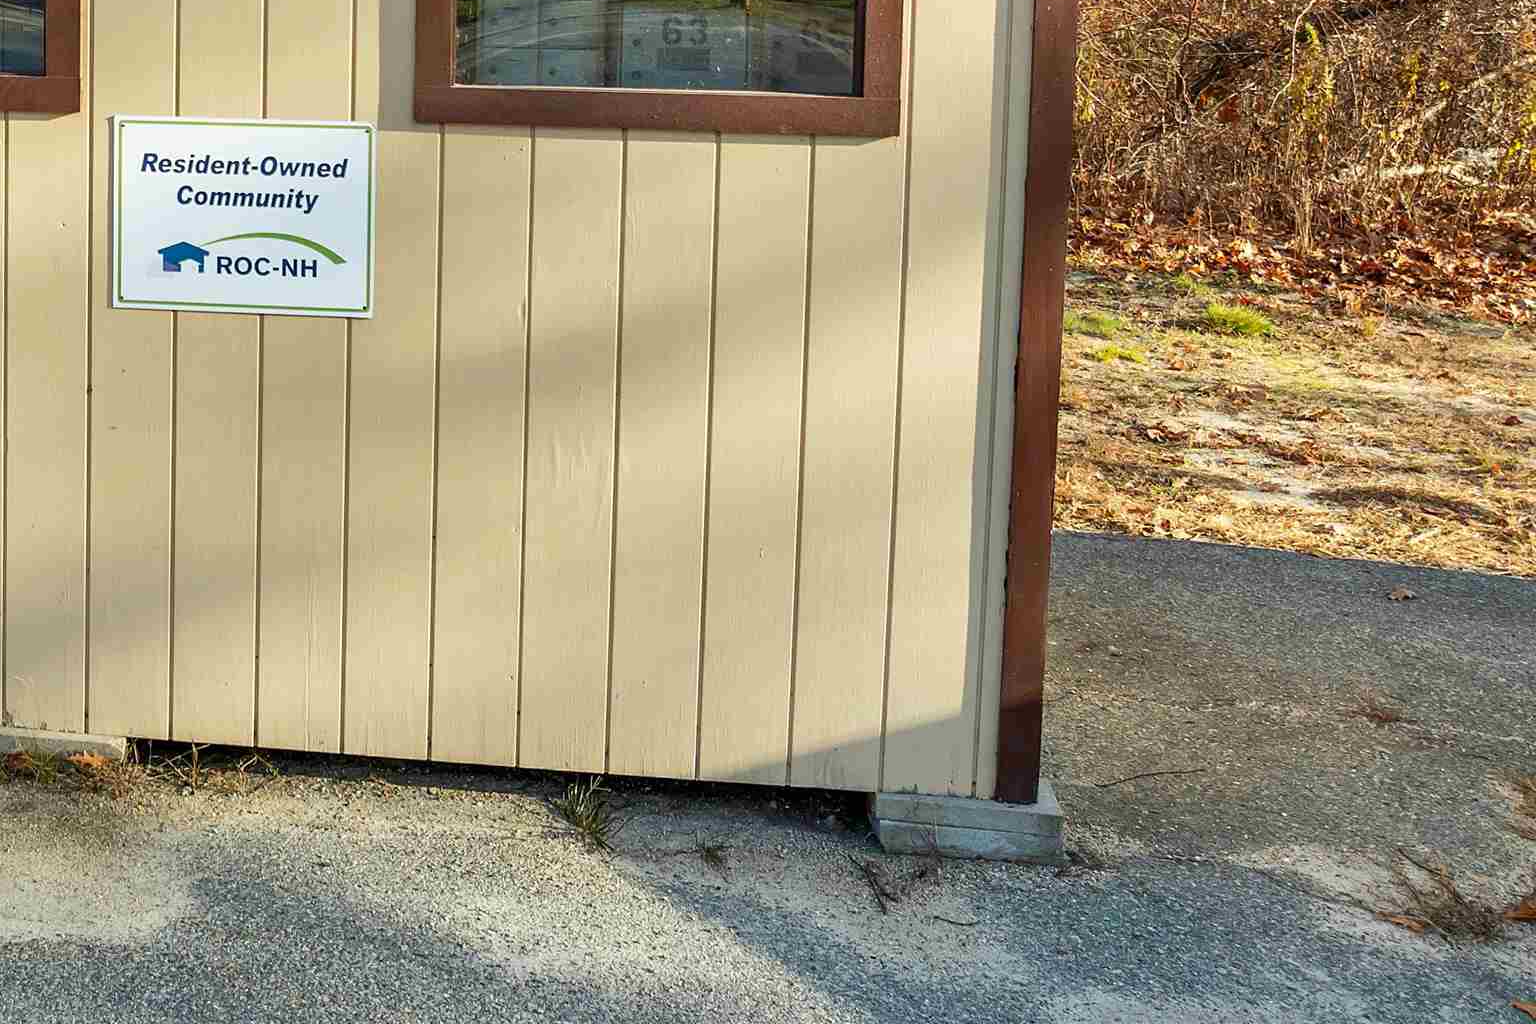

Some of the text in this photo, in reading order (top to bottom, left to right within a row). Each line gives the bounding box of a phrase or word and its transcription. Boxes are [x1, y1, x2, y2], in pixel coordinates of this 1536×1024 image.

[140, 152, 349, 178] Resident-Owned
[177, 185, 319, 214] Community
[216, 256, 318, 278] ROC-NH
